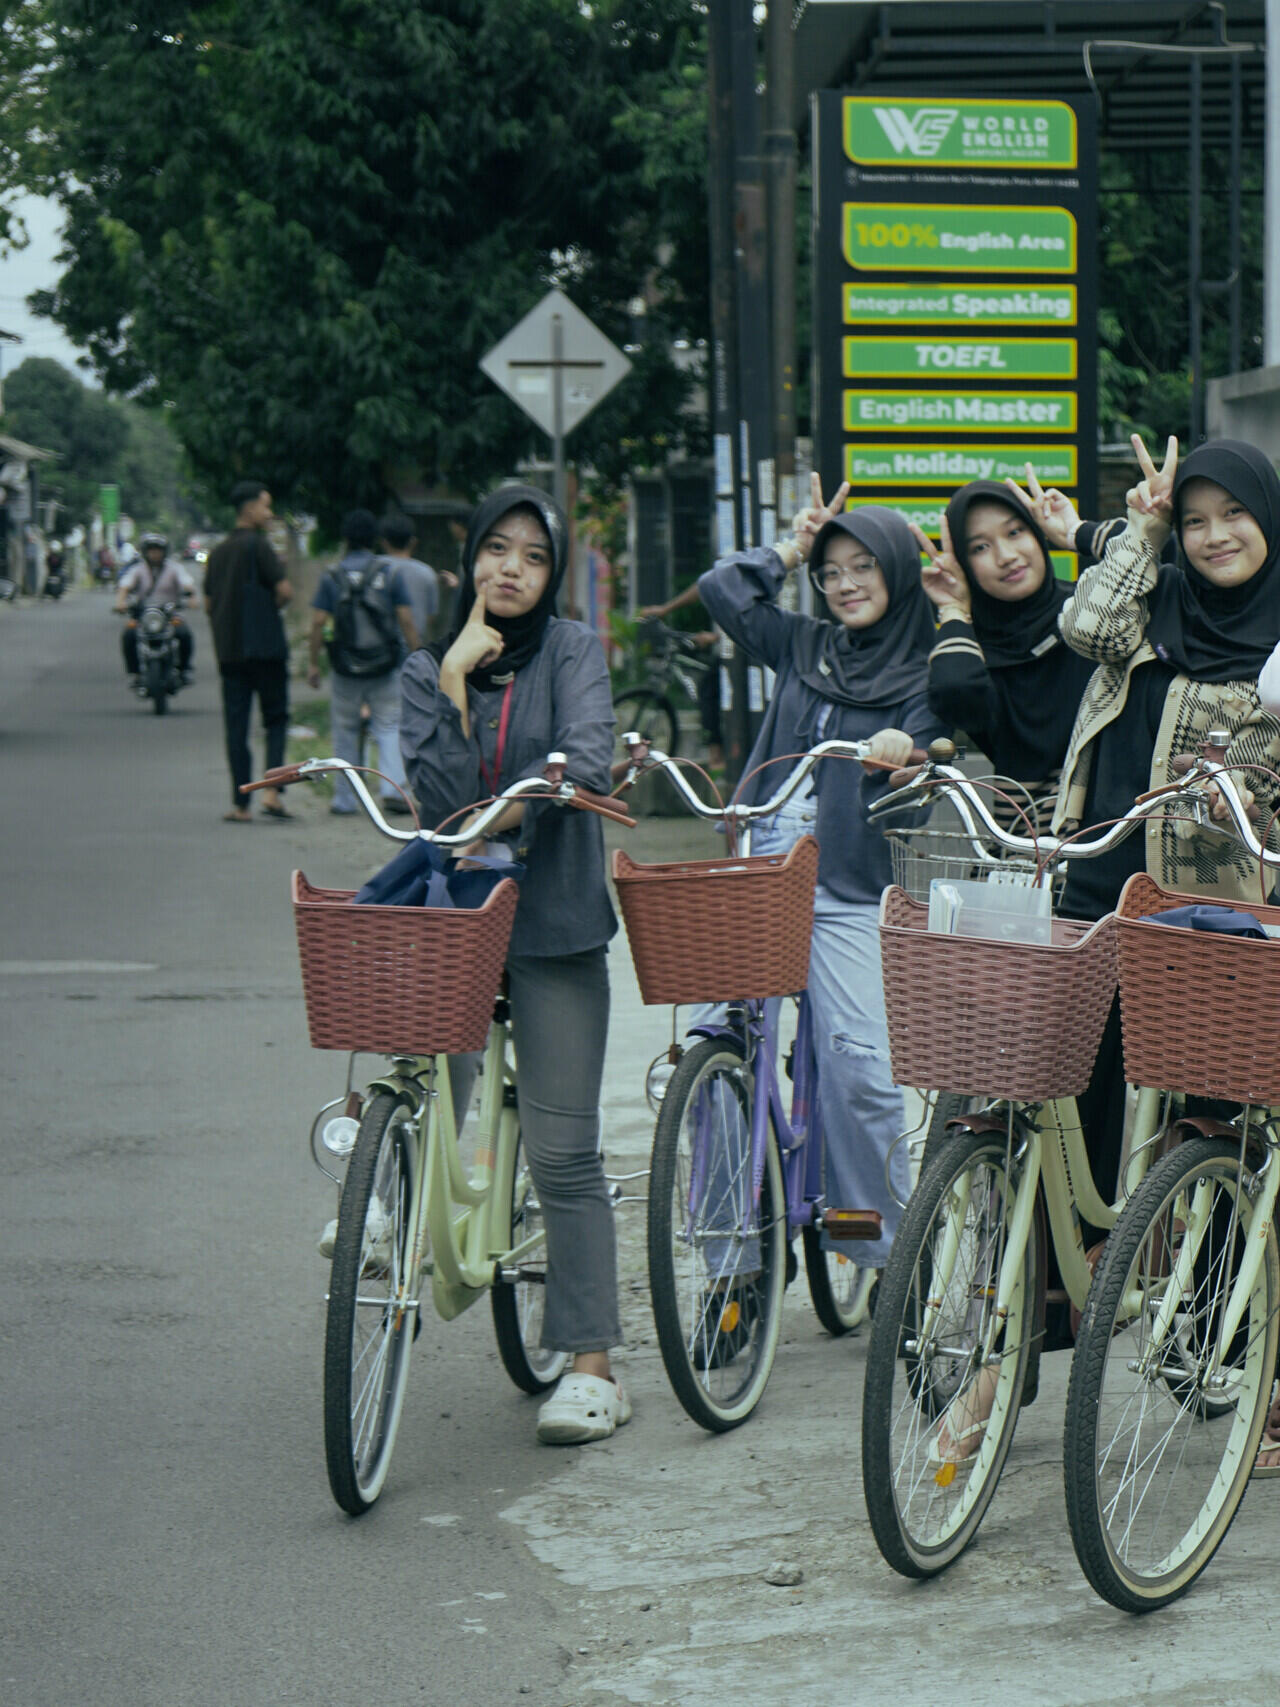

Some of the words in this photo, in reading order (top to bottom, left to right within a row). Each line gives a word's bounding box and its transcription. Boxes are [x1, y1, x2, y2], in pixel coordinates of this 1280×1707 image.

[962, 116, 1049, 132] WORLD
[961, 132, 1049, 148] ENGLISH
[855, 222, 938, 248] 100%
[940, 231, 1014, 252] English
[1018, 234, 1066, 250] Area
[850, 296, 949, 315] Integrated
[952, 293, 1071, 318] Speaking
[915, 345, 1007, 368] TOEFL
[859, 399, 952, 424] English
[954, 399, 1062, 422] Master
[853, 459, 891, 476] Fun
[893, 452, 995, 479] Holiday
[996, 462, 1070, 478] Proram
